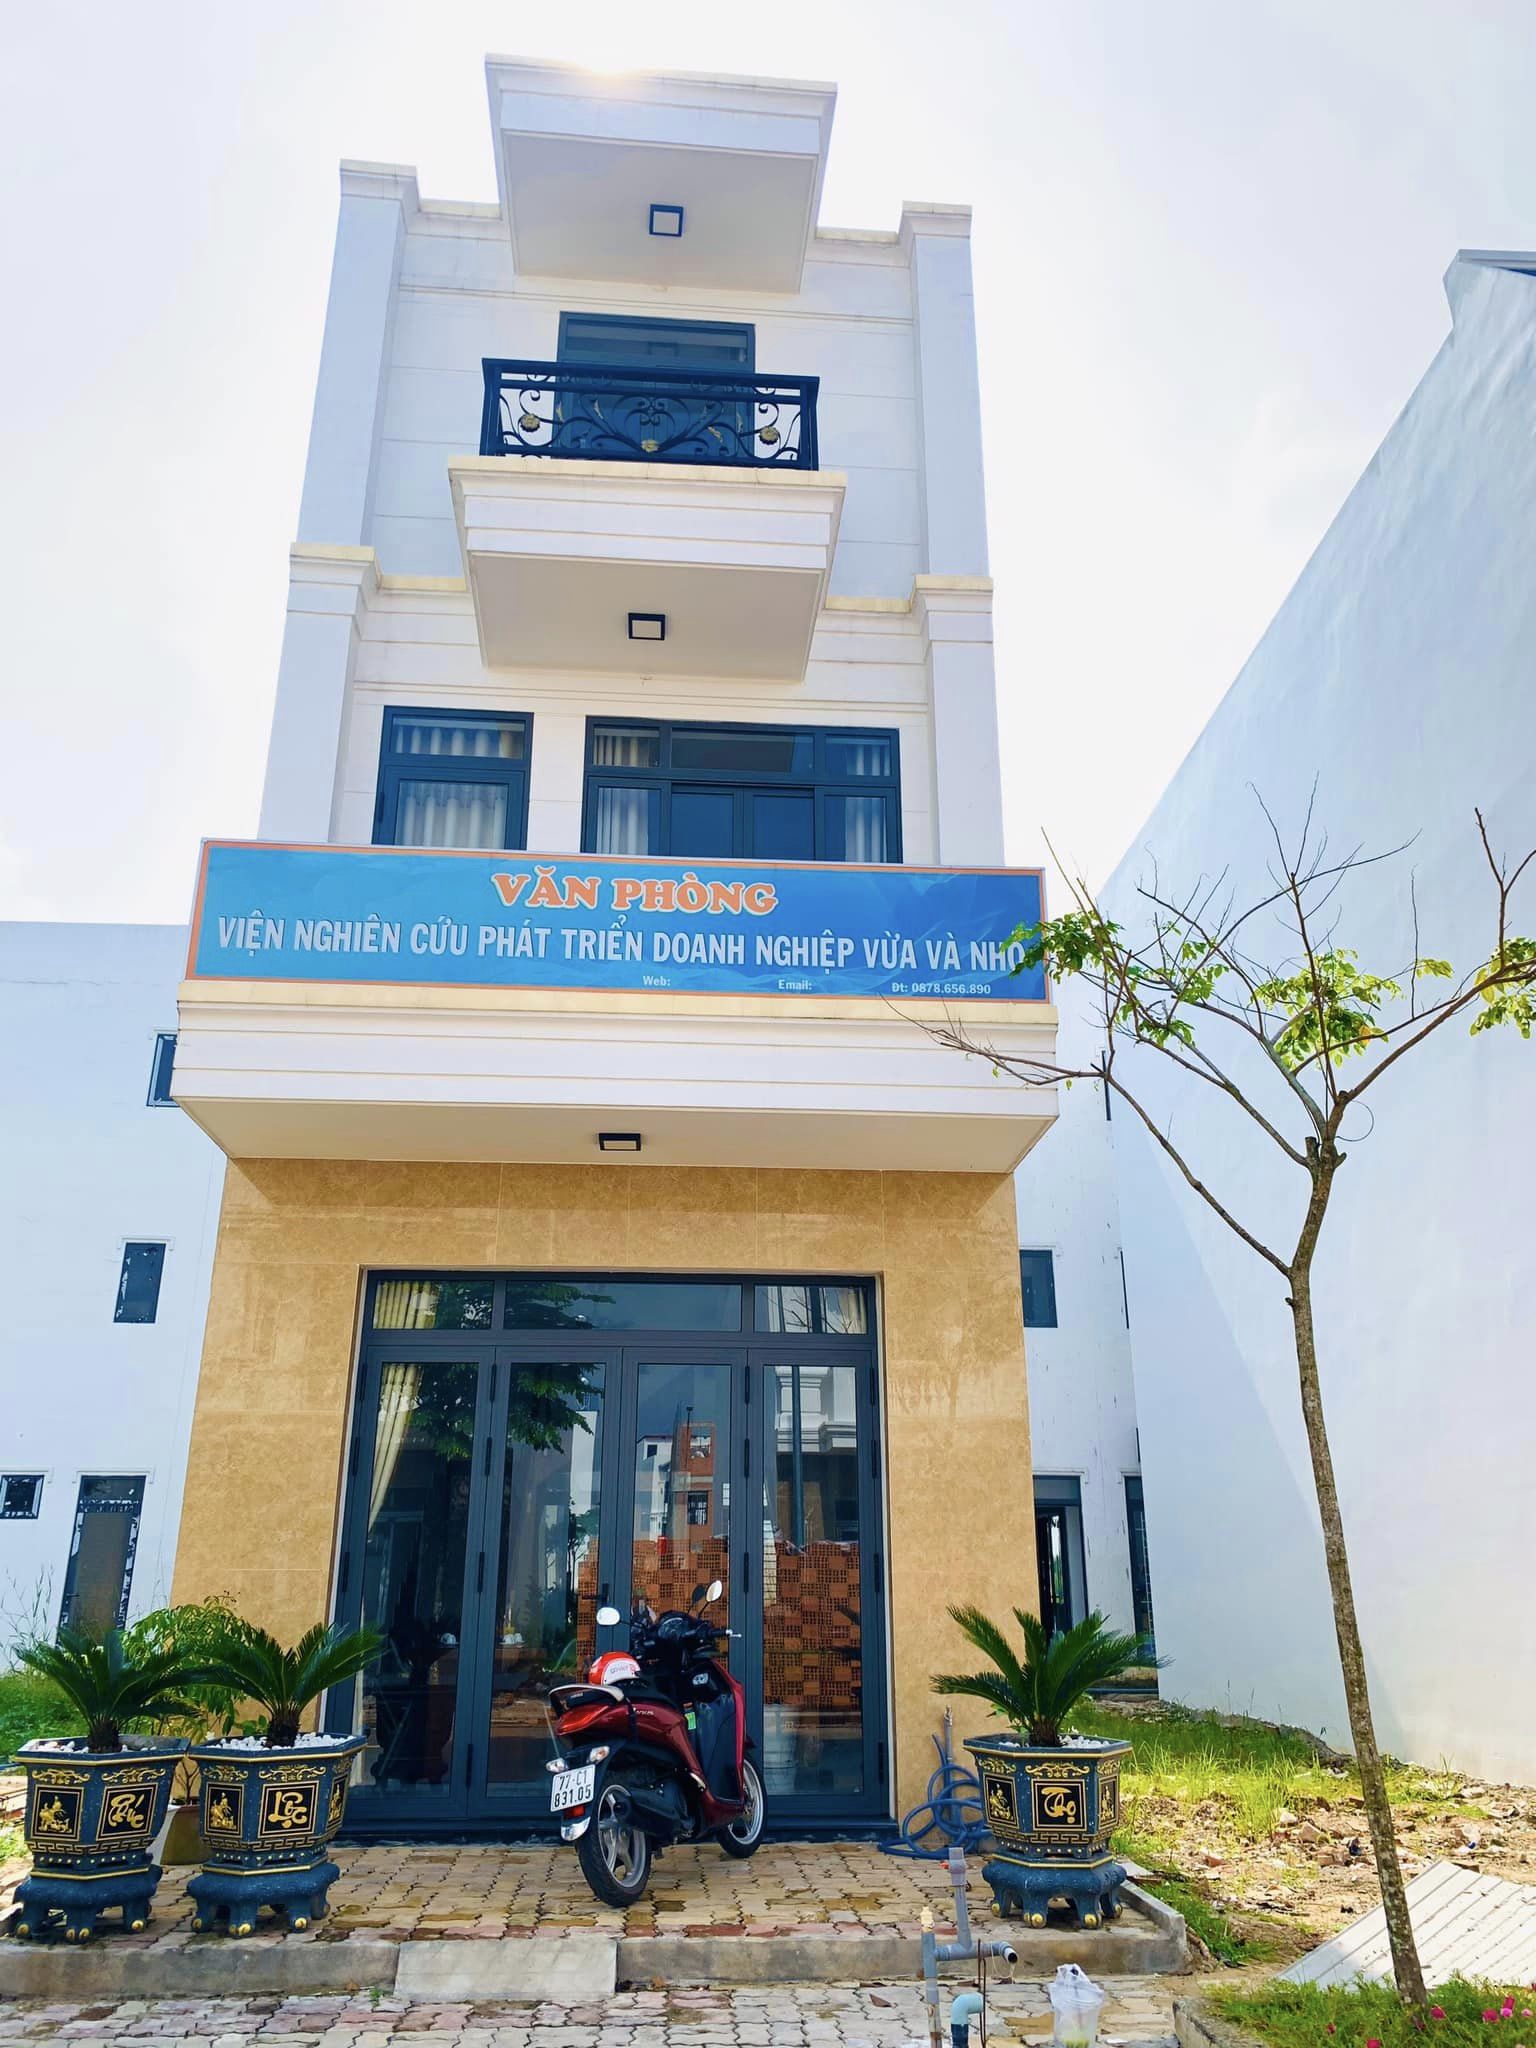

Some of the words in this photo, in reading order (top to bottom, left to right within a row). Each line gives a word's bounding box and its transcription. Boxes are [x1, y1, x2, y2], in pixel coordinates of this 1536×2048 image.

[491, 865, 602, 910] VĂN
[610, 871, 779, 916] PHÒNG
[218, 909, 286, 957] VIỆN
[293, 913, 401, 955] NGHIÊN
[410, 915, 468, 956] CỨU
[478, 919, 552, 960] PHÁT
[561, 914, 643, 961] TRIỂN
[653, 931, 745, 966] DOANH
[755, 929, 855, 975] NGHIỆP
[863, 931, 918, 970] VỪA
[926, 932, 961, 971] VÀ
[642, 975, 671, 987] Web:
[777, 979, 813, 991] Email:
[891, 982, 909, 993] Đt:
[911, 982, 992, 994] 0878.656.890
